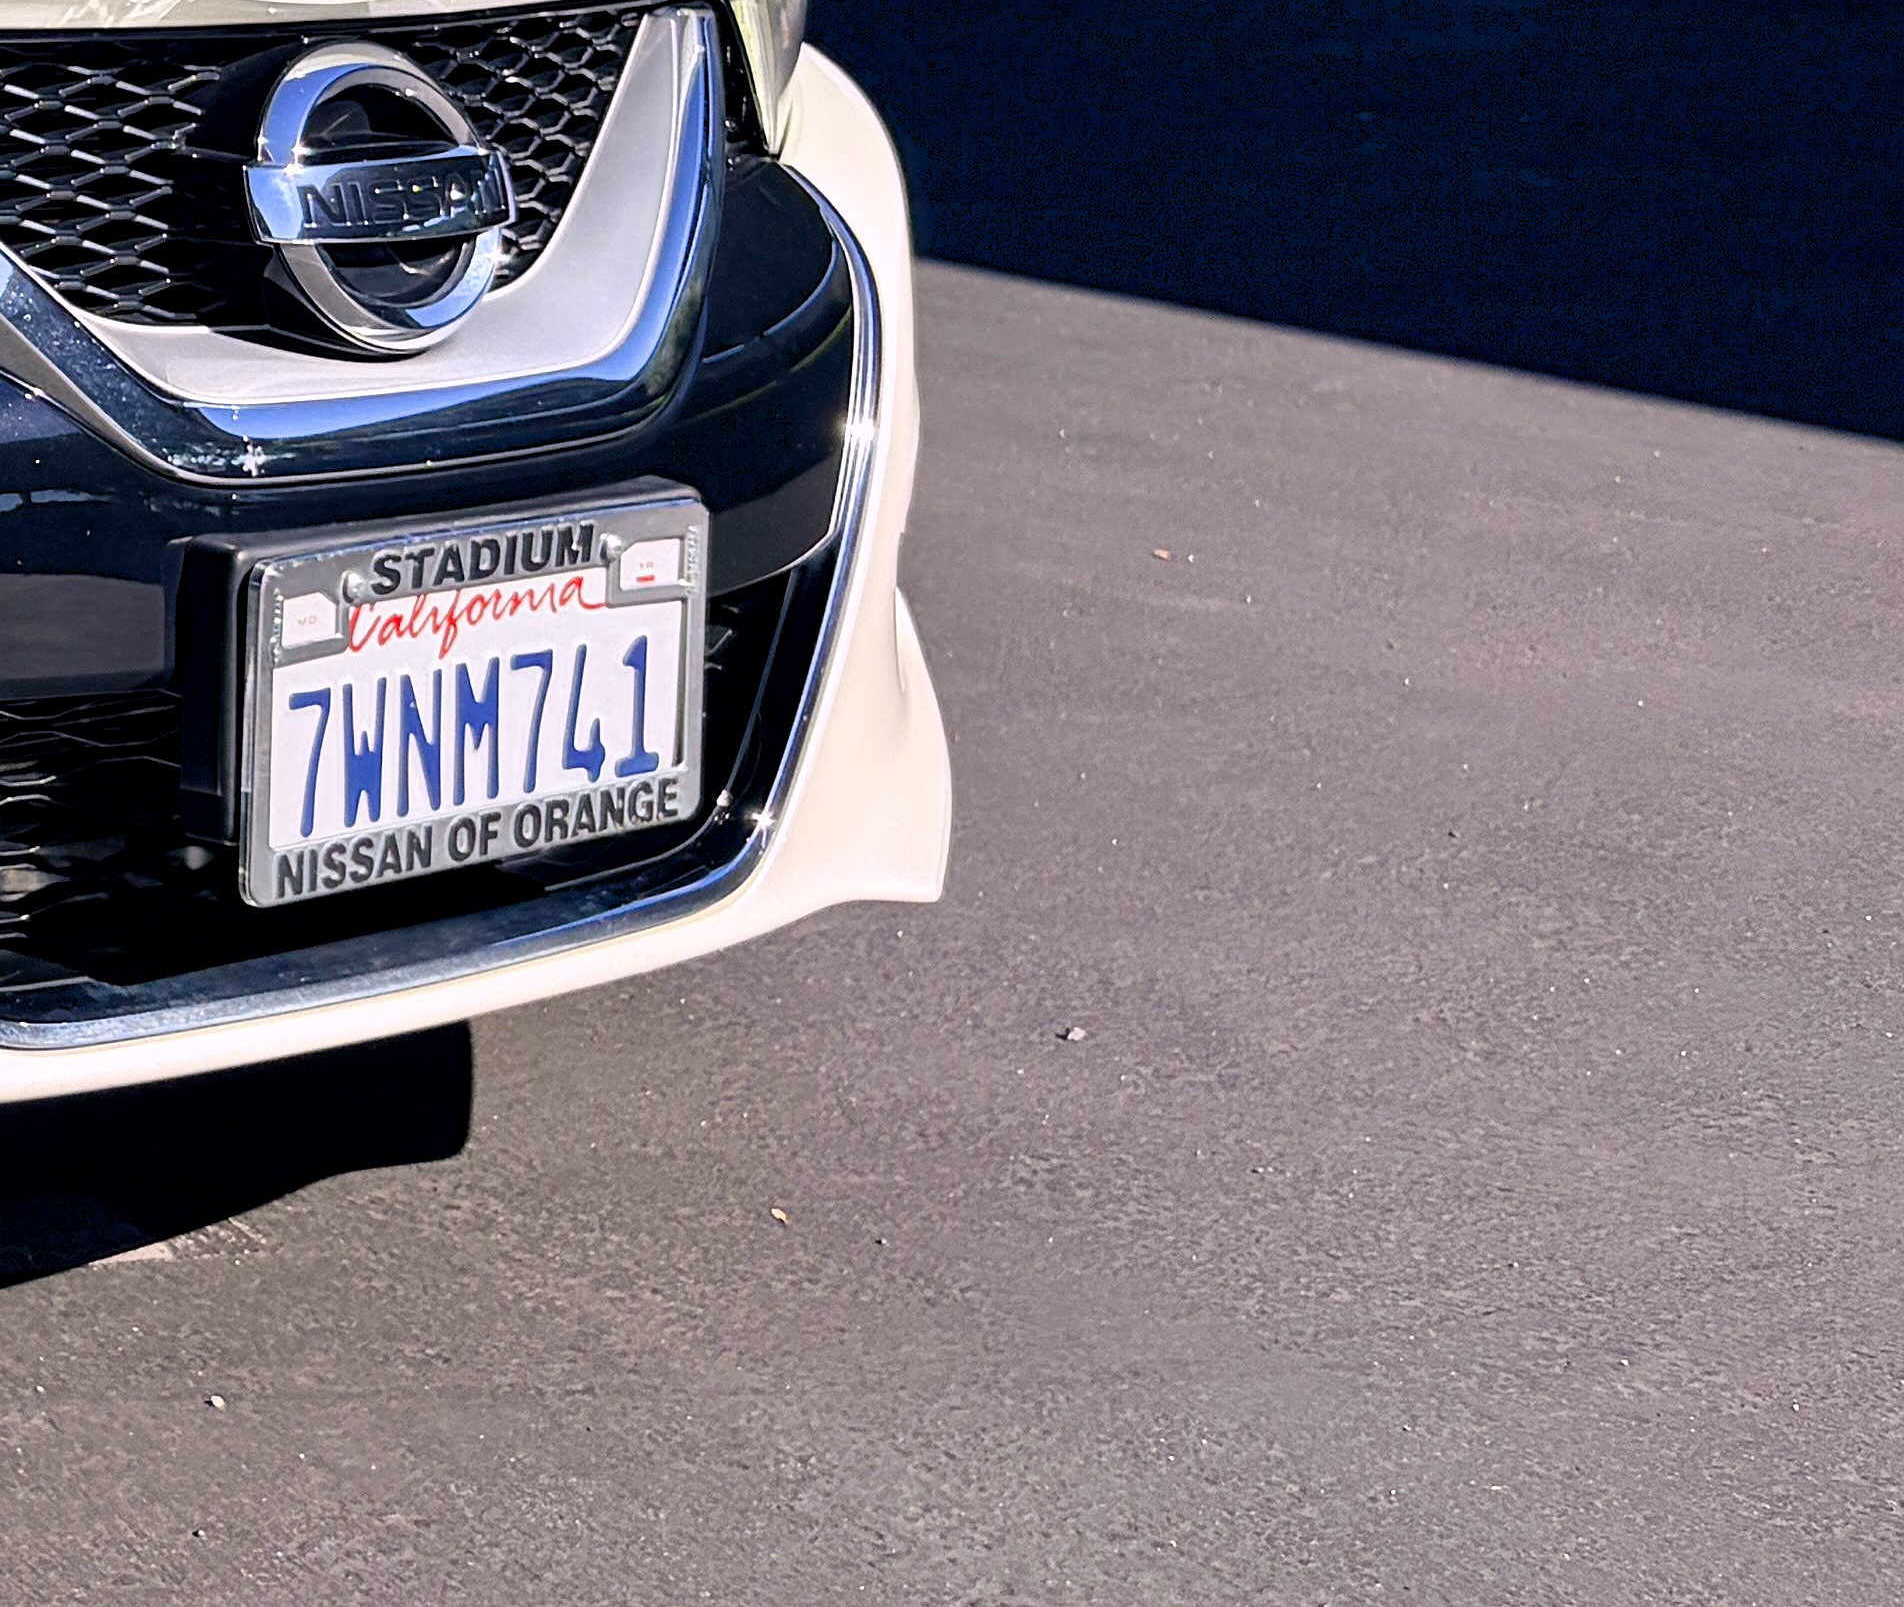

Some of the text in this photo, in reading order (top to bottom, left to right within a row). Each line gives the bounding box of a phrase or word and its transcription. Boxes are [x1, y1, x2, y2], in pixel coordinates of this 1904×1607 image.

[296, 170, 506, 228] NISSAN
[372, 523, 594, 594] STADIUM
[347, 576, 607, 658] California
[288, 634, 659, 838] 7WNM741
[275, 776, 679, 897] NISSAN OF ORANGE
